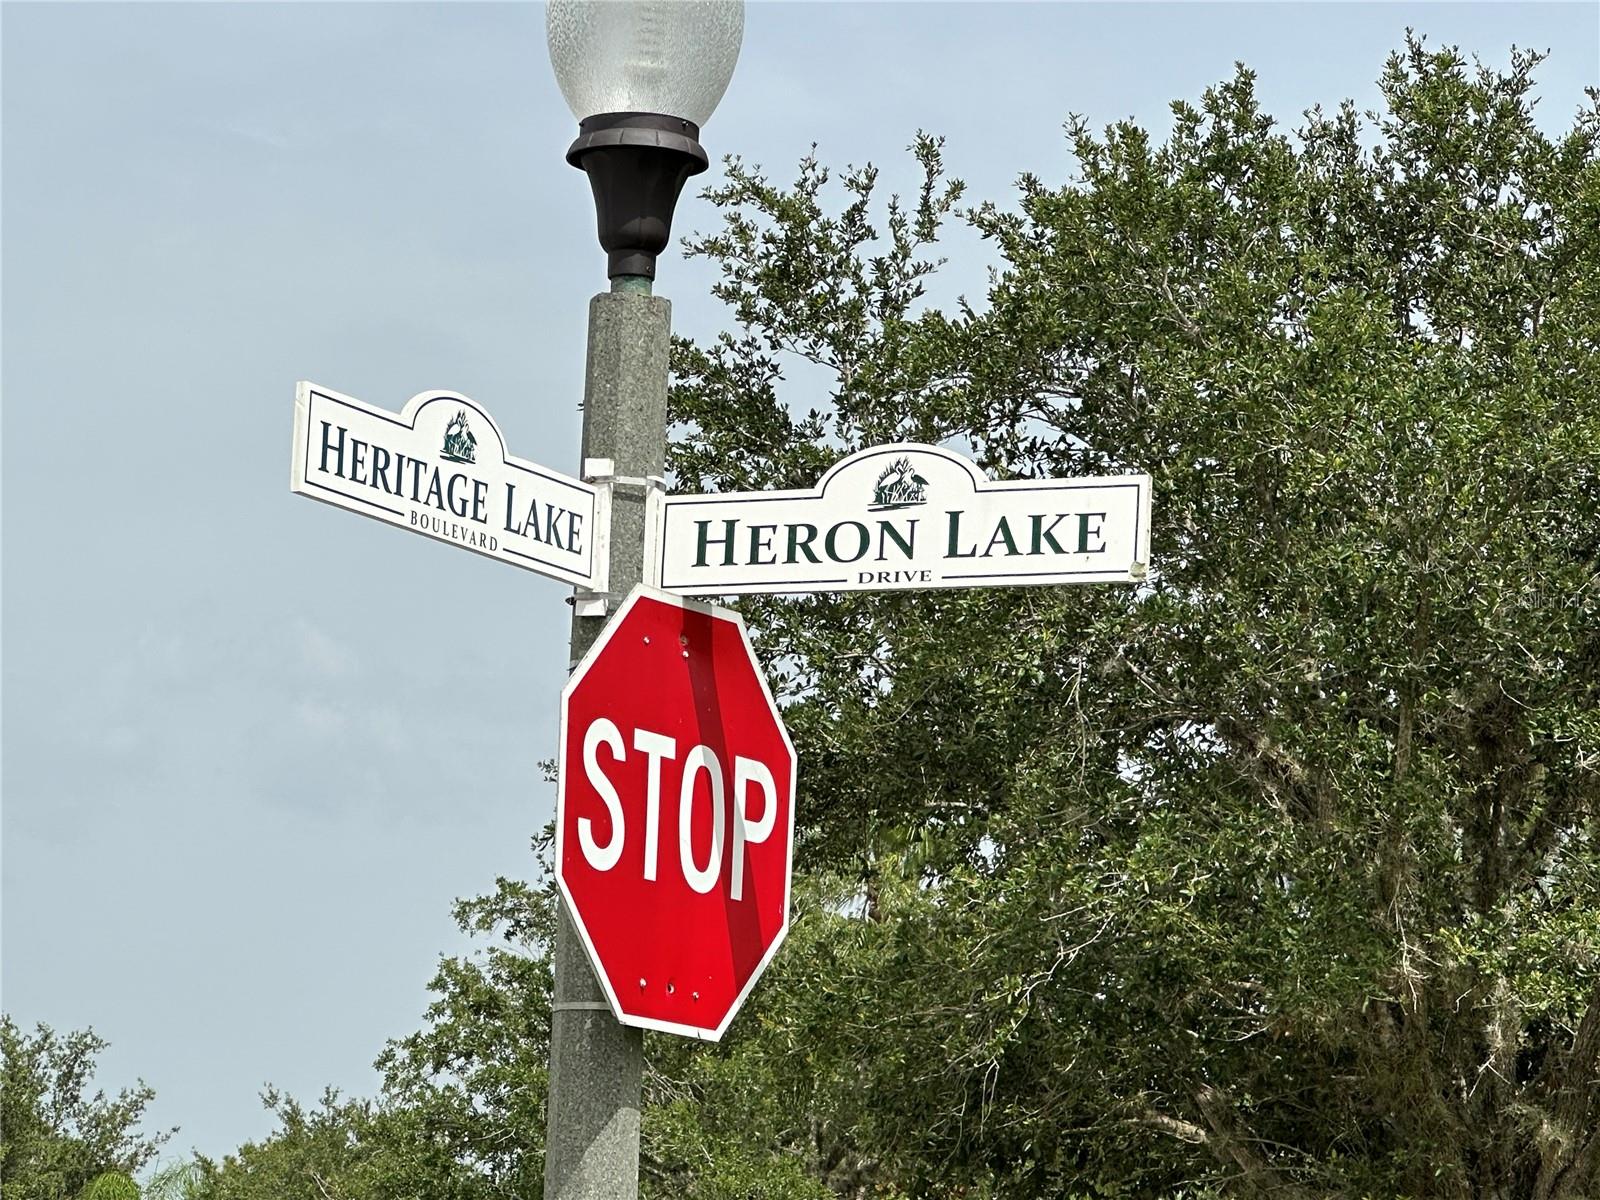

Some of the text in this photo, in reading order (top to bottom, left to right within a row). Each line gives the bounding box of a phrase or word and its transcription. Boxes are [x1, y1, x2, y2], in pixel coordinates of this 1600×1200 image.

[318, 420, 583, 555] HERITAGE LAKE
[410, 510, 498, 552] BOULEVARD
[691, 510, 1107, 567] HERON LAKE
[857, 569, 932, 584] DRIVE
[577, 717, 777, 901] STOP
